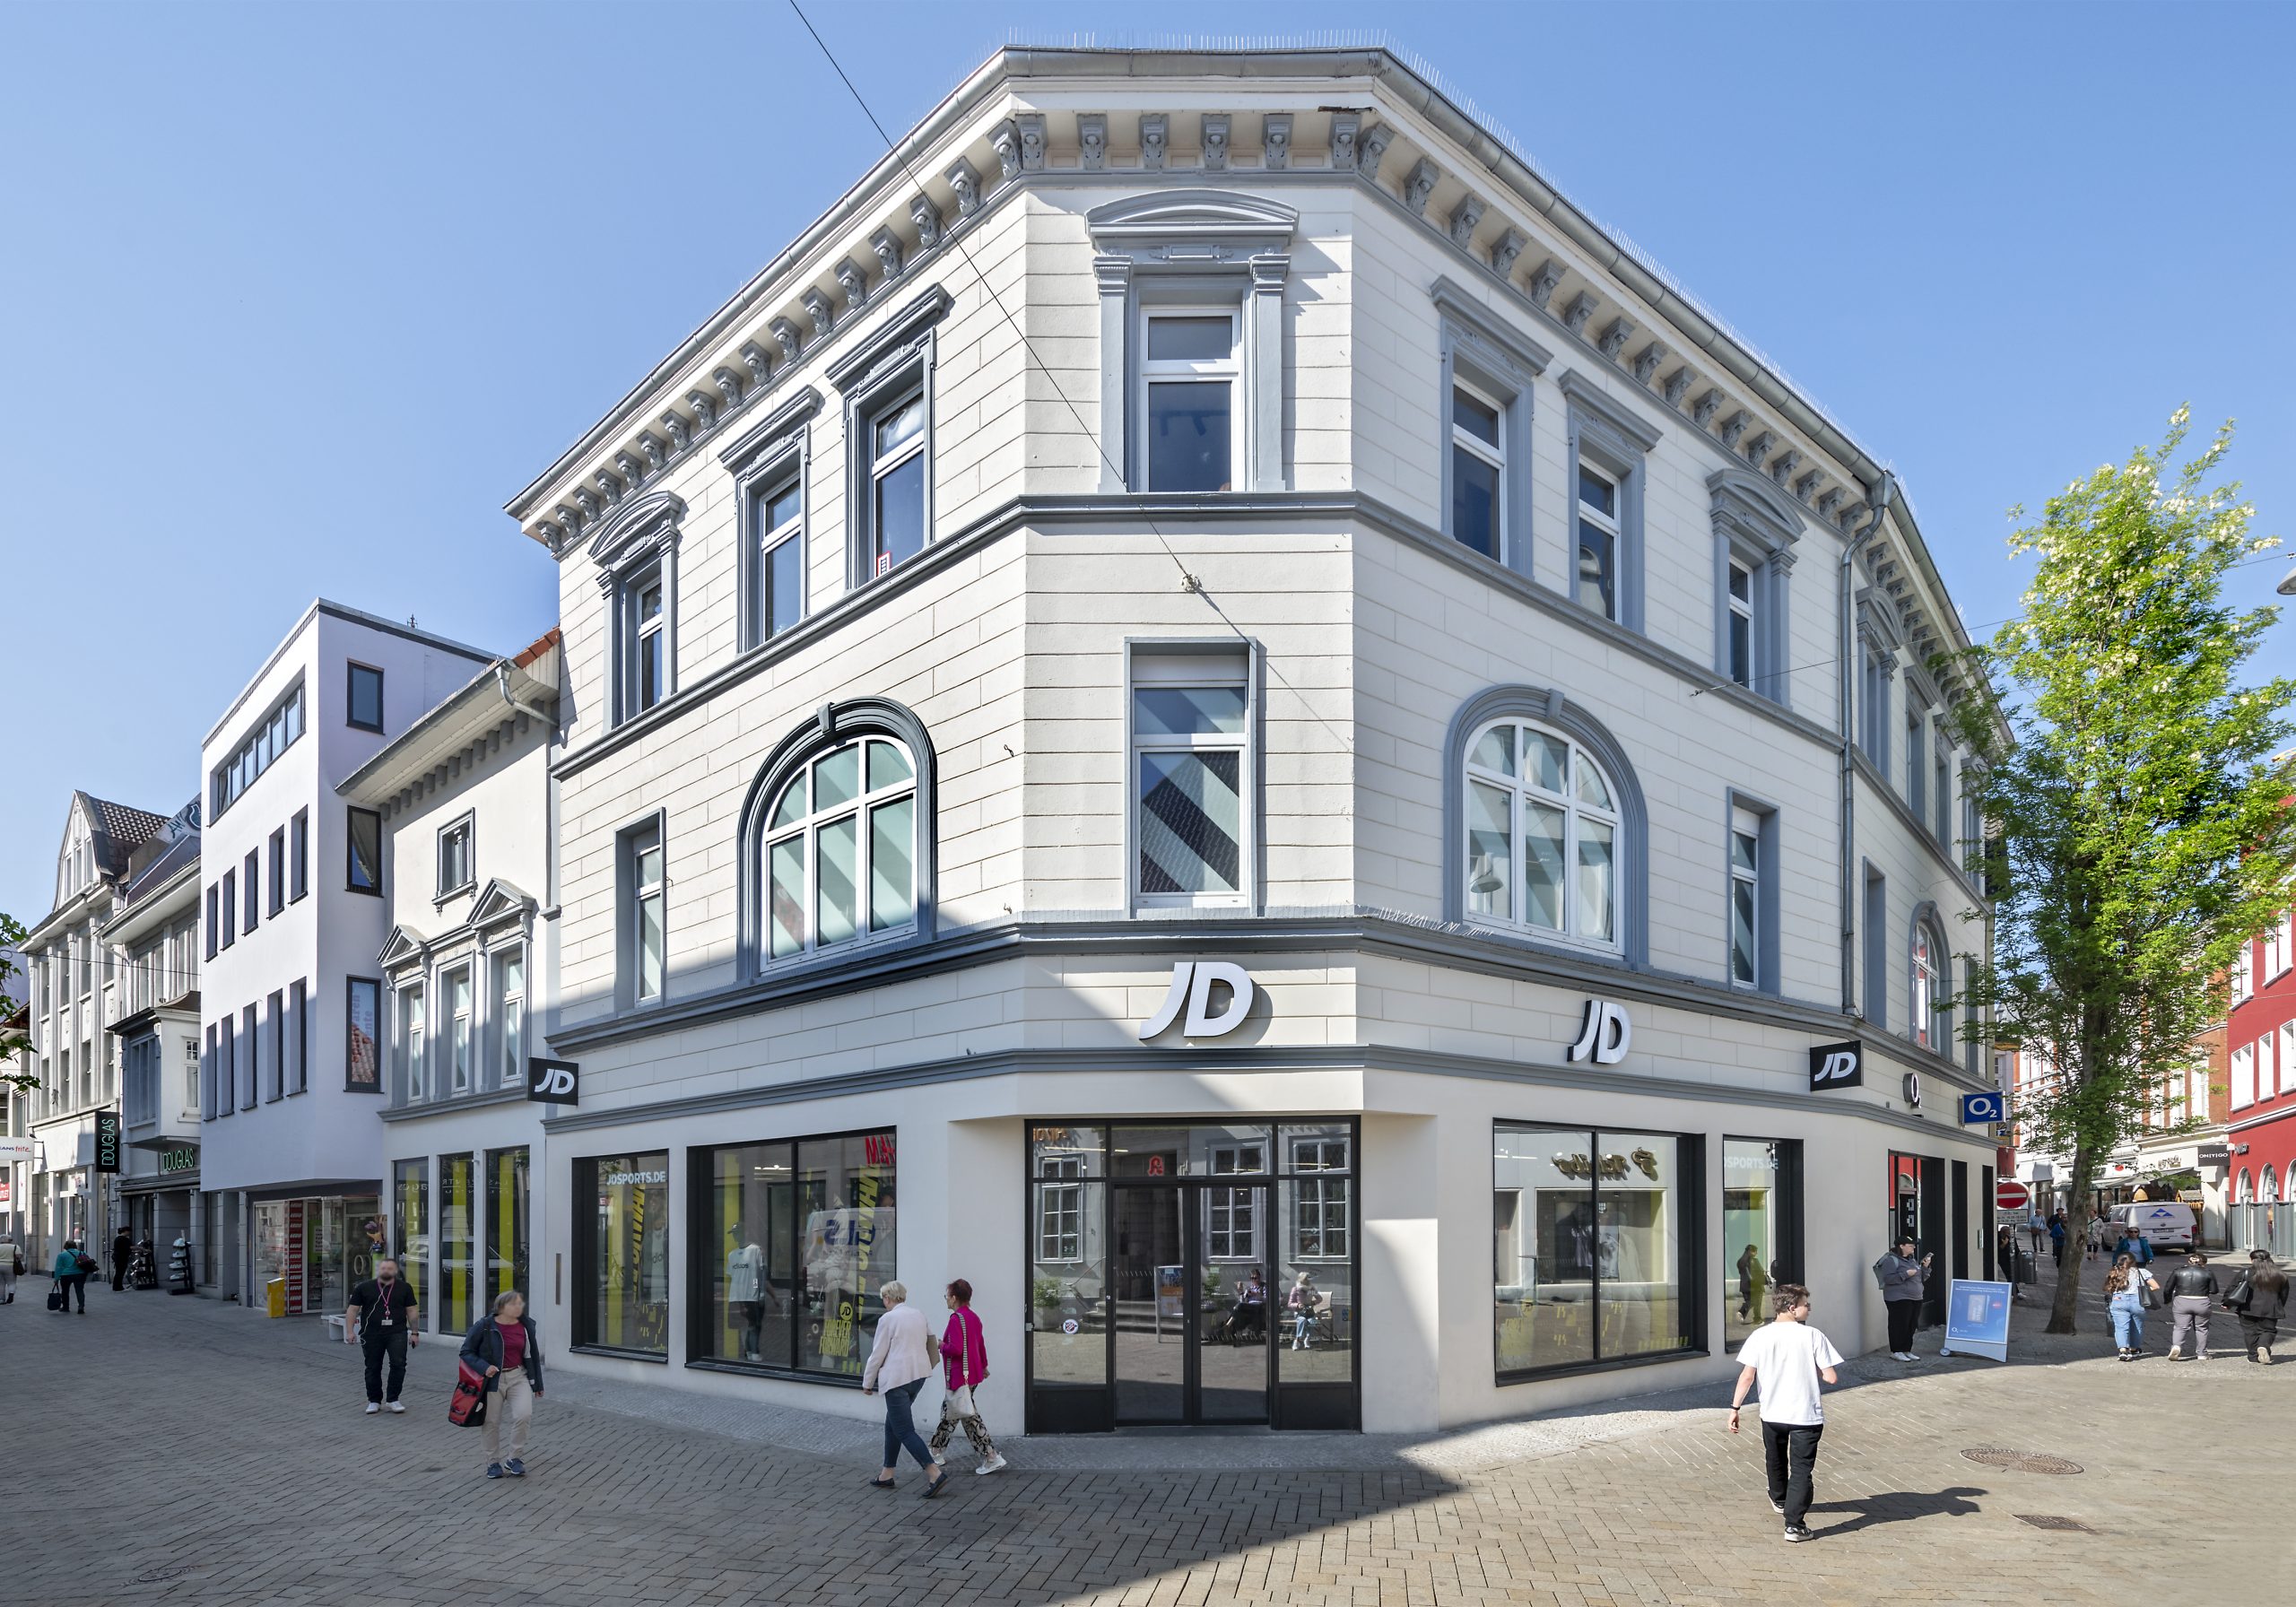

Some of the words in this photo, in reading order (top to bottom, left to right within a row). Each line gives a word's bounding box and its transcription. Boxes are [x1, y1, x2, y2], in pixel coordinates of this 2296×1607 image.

[1140, 962, 1254, 1039] JD
[1567, 1000, 1631, 1064] JD
[1814, 1052, 1857, 1082] JD
[535, 1069, 575, 1095] JD
[101, 1118, 115, 1166] DOUGLAS
[162, 1148, 194, 1171] DOUGLAS
[1724, 1156, 1779, 1170] SPORTS.DE
[606, 1171, 666, 1186] JDSPORTS.DE
